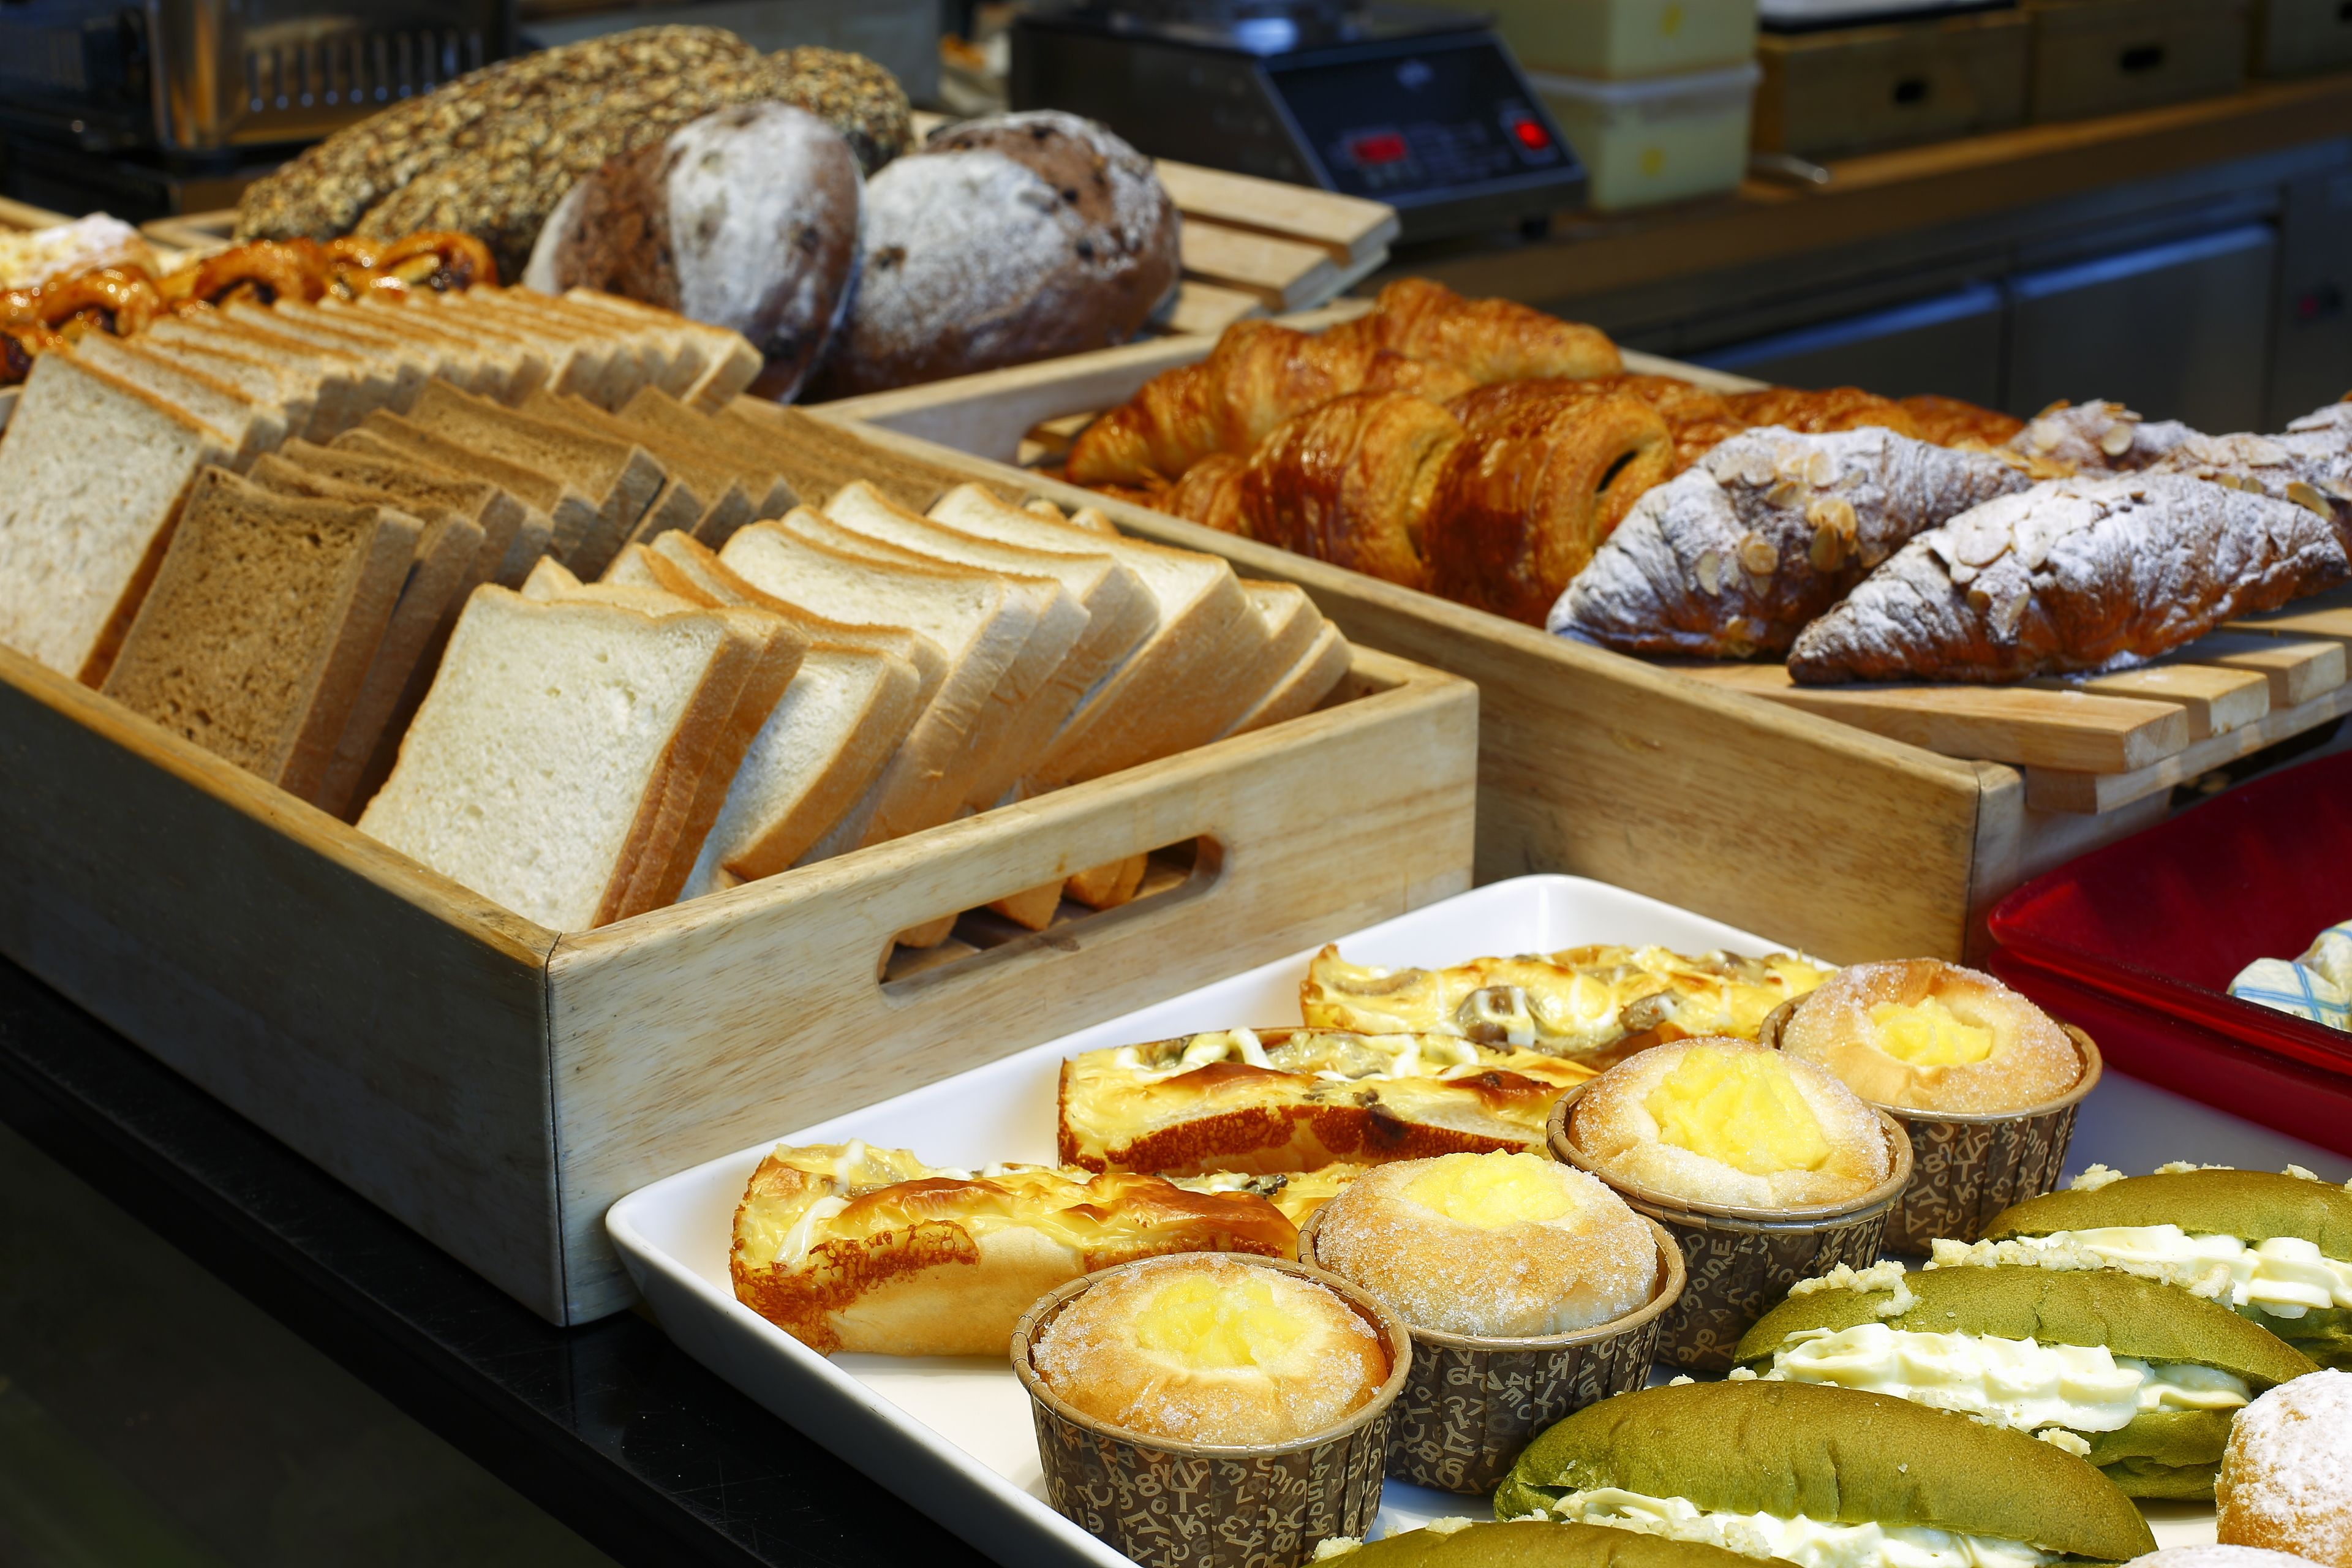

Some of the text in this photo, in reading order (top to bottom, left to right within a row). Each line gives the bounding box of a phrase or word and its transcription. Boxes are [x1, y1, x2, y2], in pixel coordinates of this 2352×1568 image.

[1923, 1153, 1946, 1174] 8
[1710, 1239, 1731, 1256] E
[1447, 1368, 1467, 1385] 6
[1505, 1372, 1525, 1387] 4
[1499, 1386, 1525, 1408] E
[1417, 1441, 1444, 1463] 8
[1135, 1474, 1162, 1496] 8
